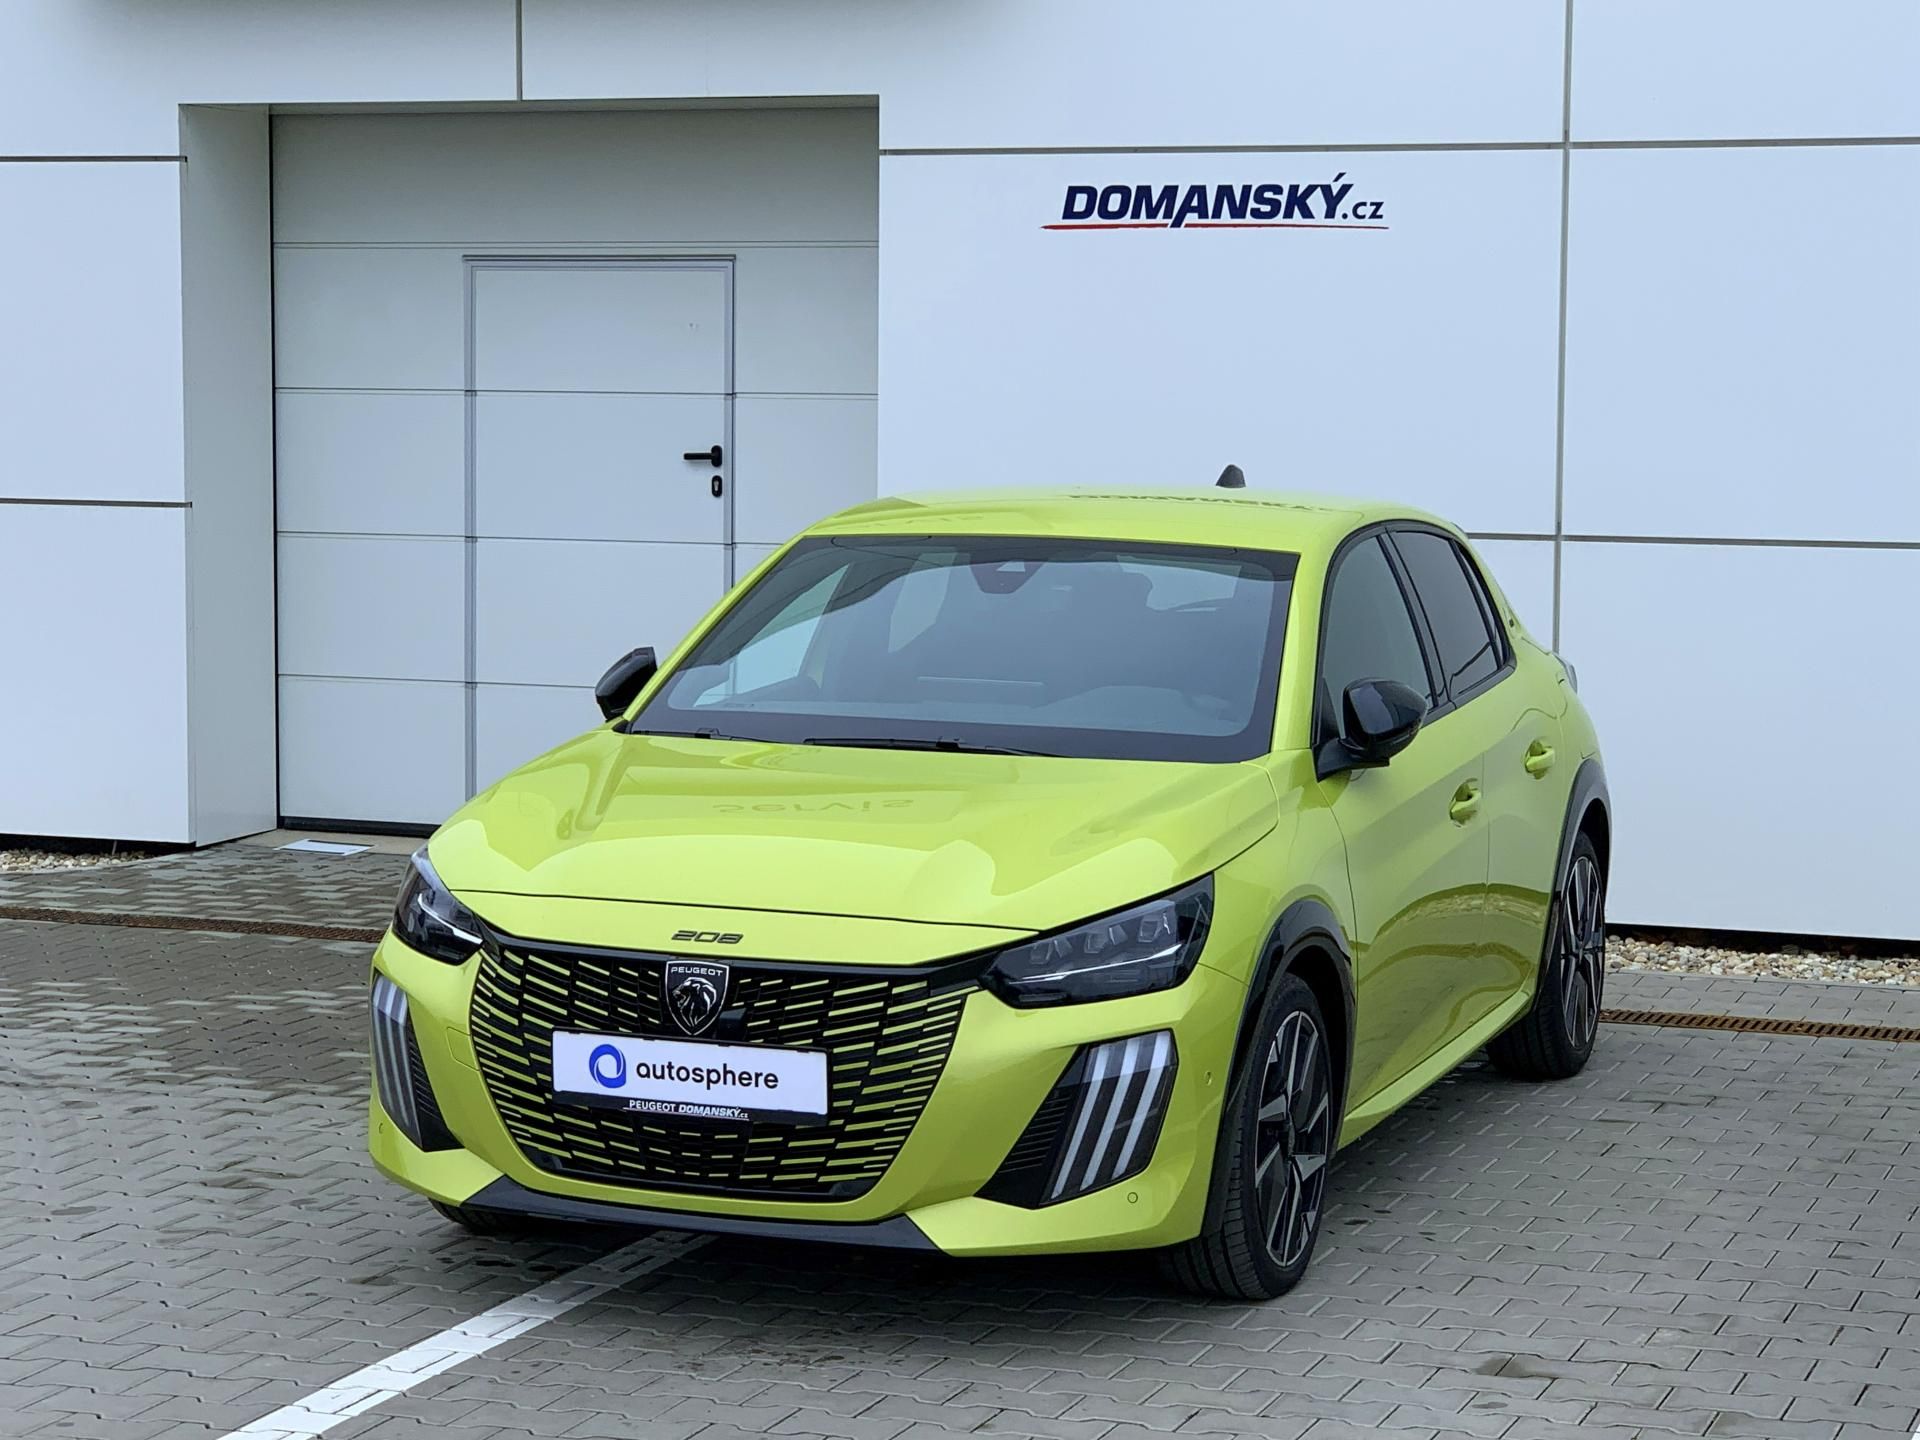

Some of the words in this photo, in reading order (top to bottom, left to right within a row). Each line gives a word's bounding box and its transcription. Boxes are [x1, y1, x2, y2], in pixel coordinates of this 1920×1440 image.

[1061, 172, 1385, 228] DOMANSKÝ.cz
[671, 930, 744, 944] 208
[670, 966, 724, 976] PEUGEOT
[636, 1060, 779, 1090] autosphere
[629, 1099, 676, 1112] PEUGEOT
